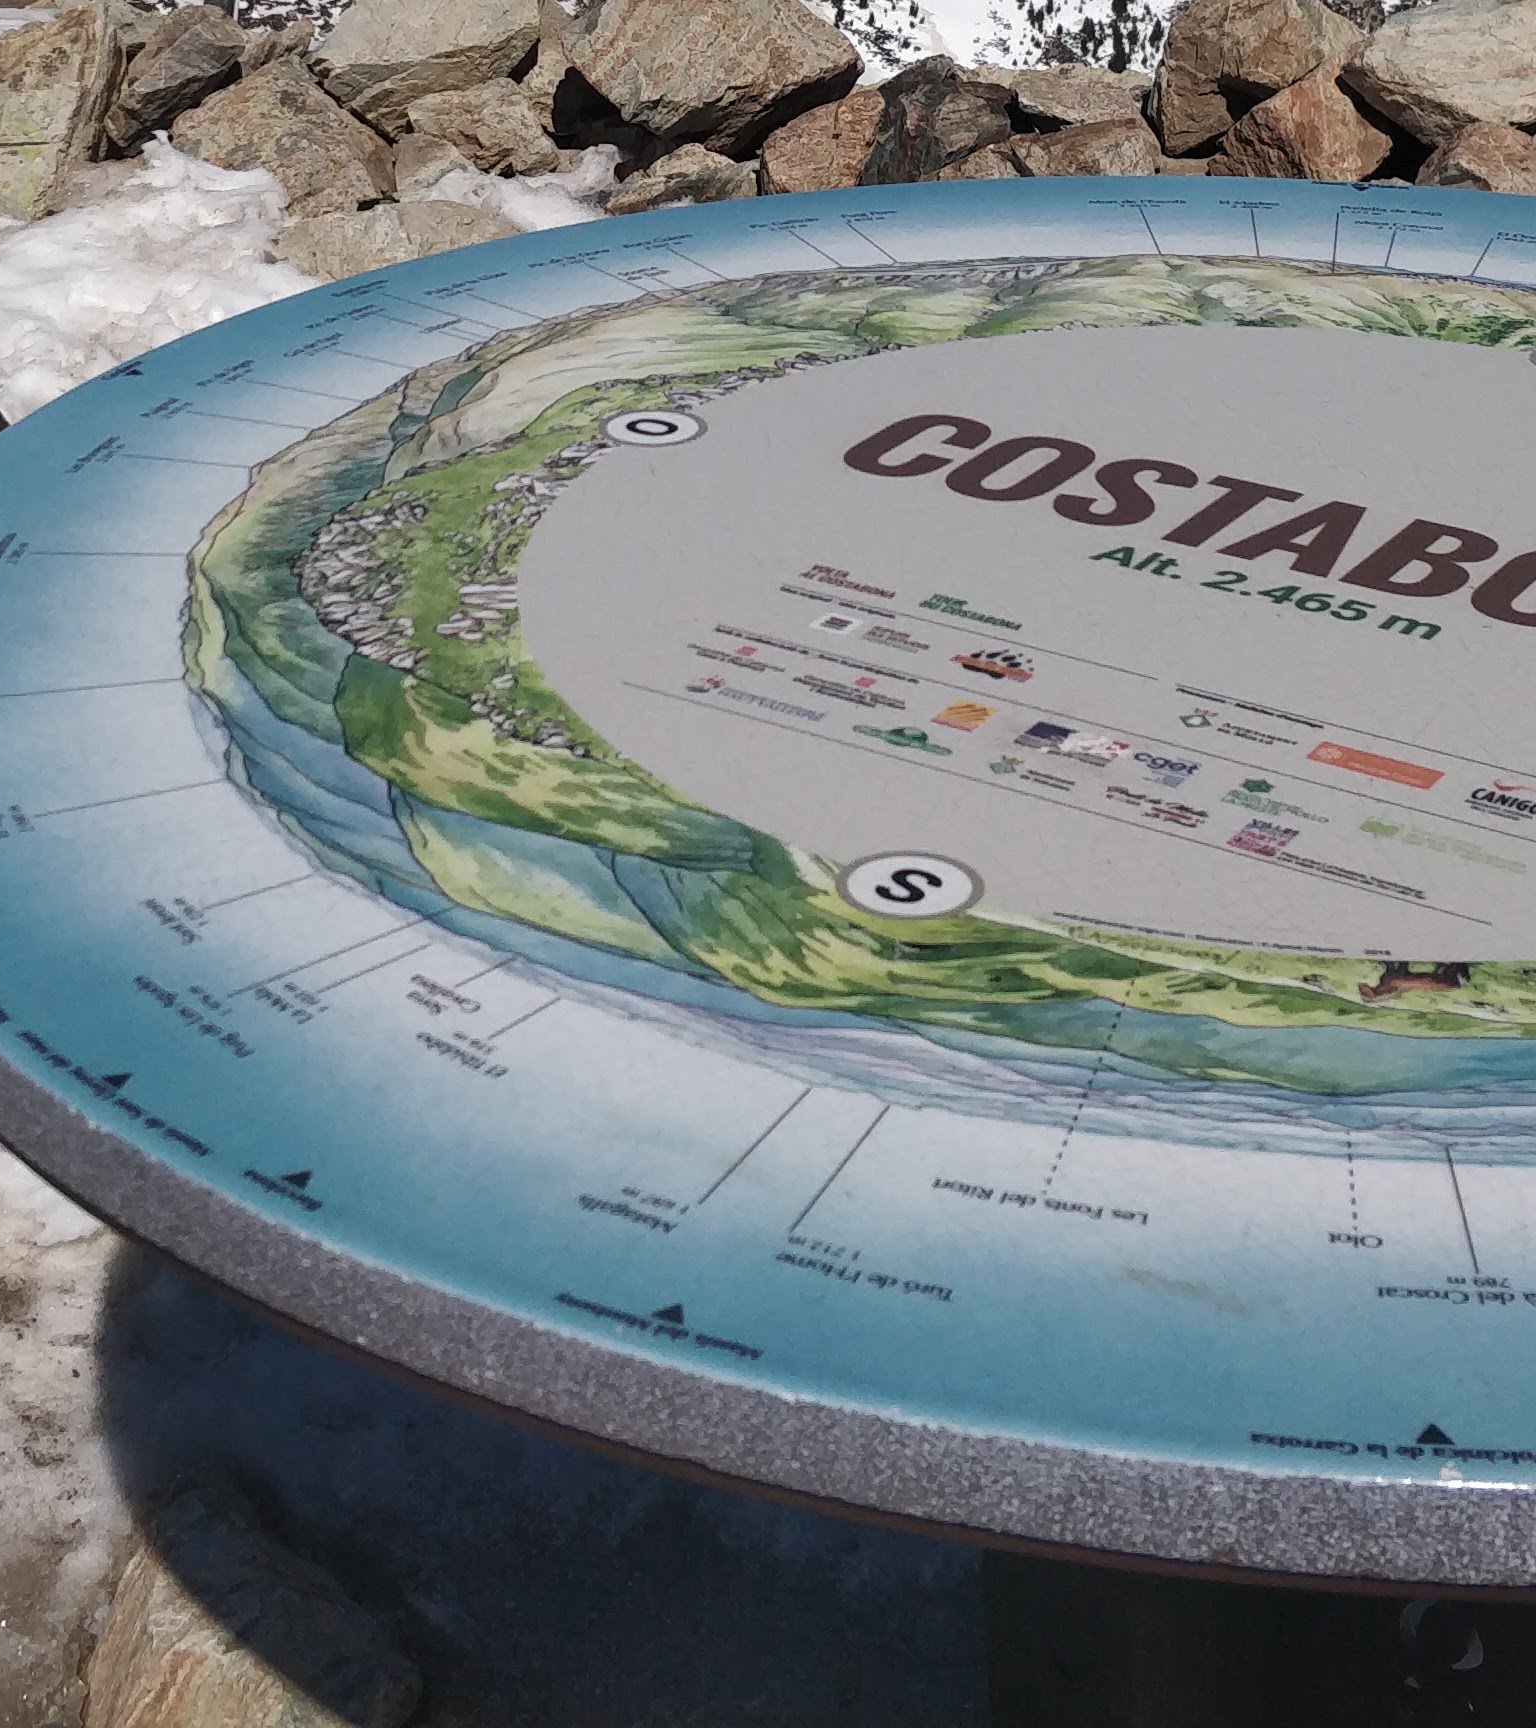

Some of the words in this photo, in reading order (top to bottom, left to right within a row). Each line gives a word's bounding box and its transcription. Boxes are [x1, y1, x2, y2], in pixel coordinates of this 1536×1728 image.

[624, 417, 680, 438] O
[1088, 542, 1183, 583] Alt.
[1200, 569, 1377, 623] 2.465
[1374, 614, 1444, 642] m
[874, 867, 944, 906] S
[1000, 1192, 1037, 1208] del
[1044, 1198, 1103, 1219] Fonts
[1111, 1209, 1148, 1225] Les
[1329, 1233, 1383, 1248] Olot
[1376, 1287, 1470, 1304] Croscat
[1476, 1291, 1515, 1305] del
